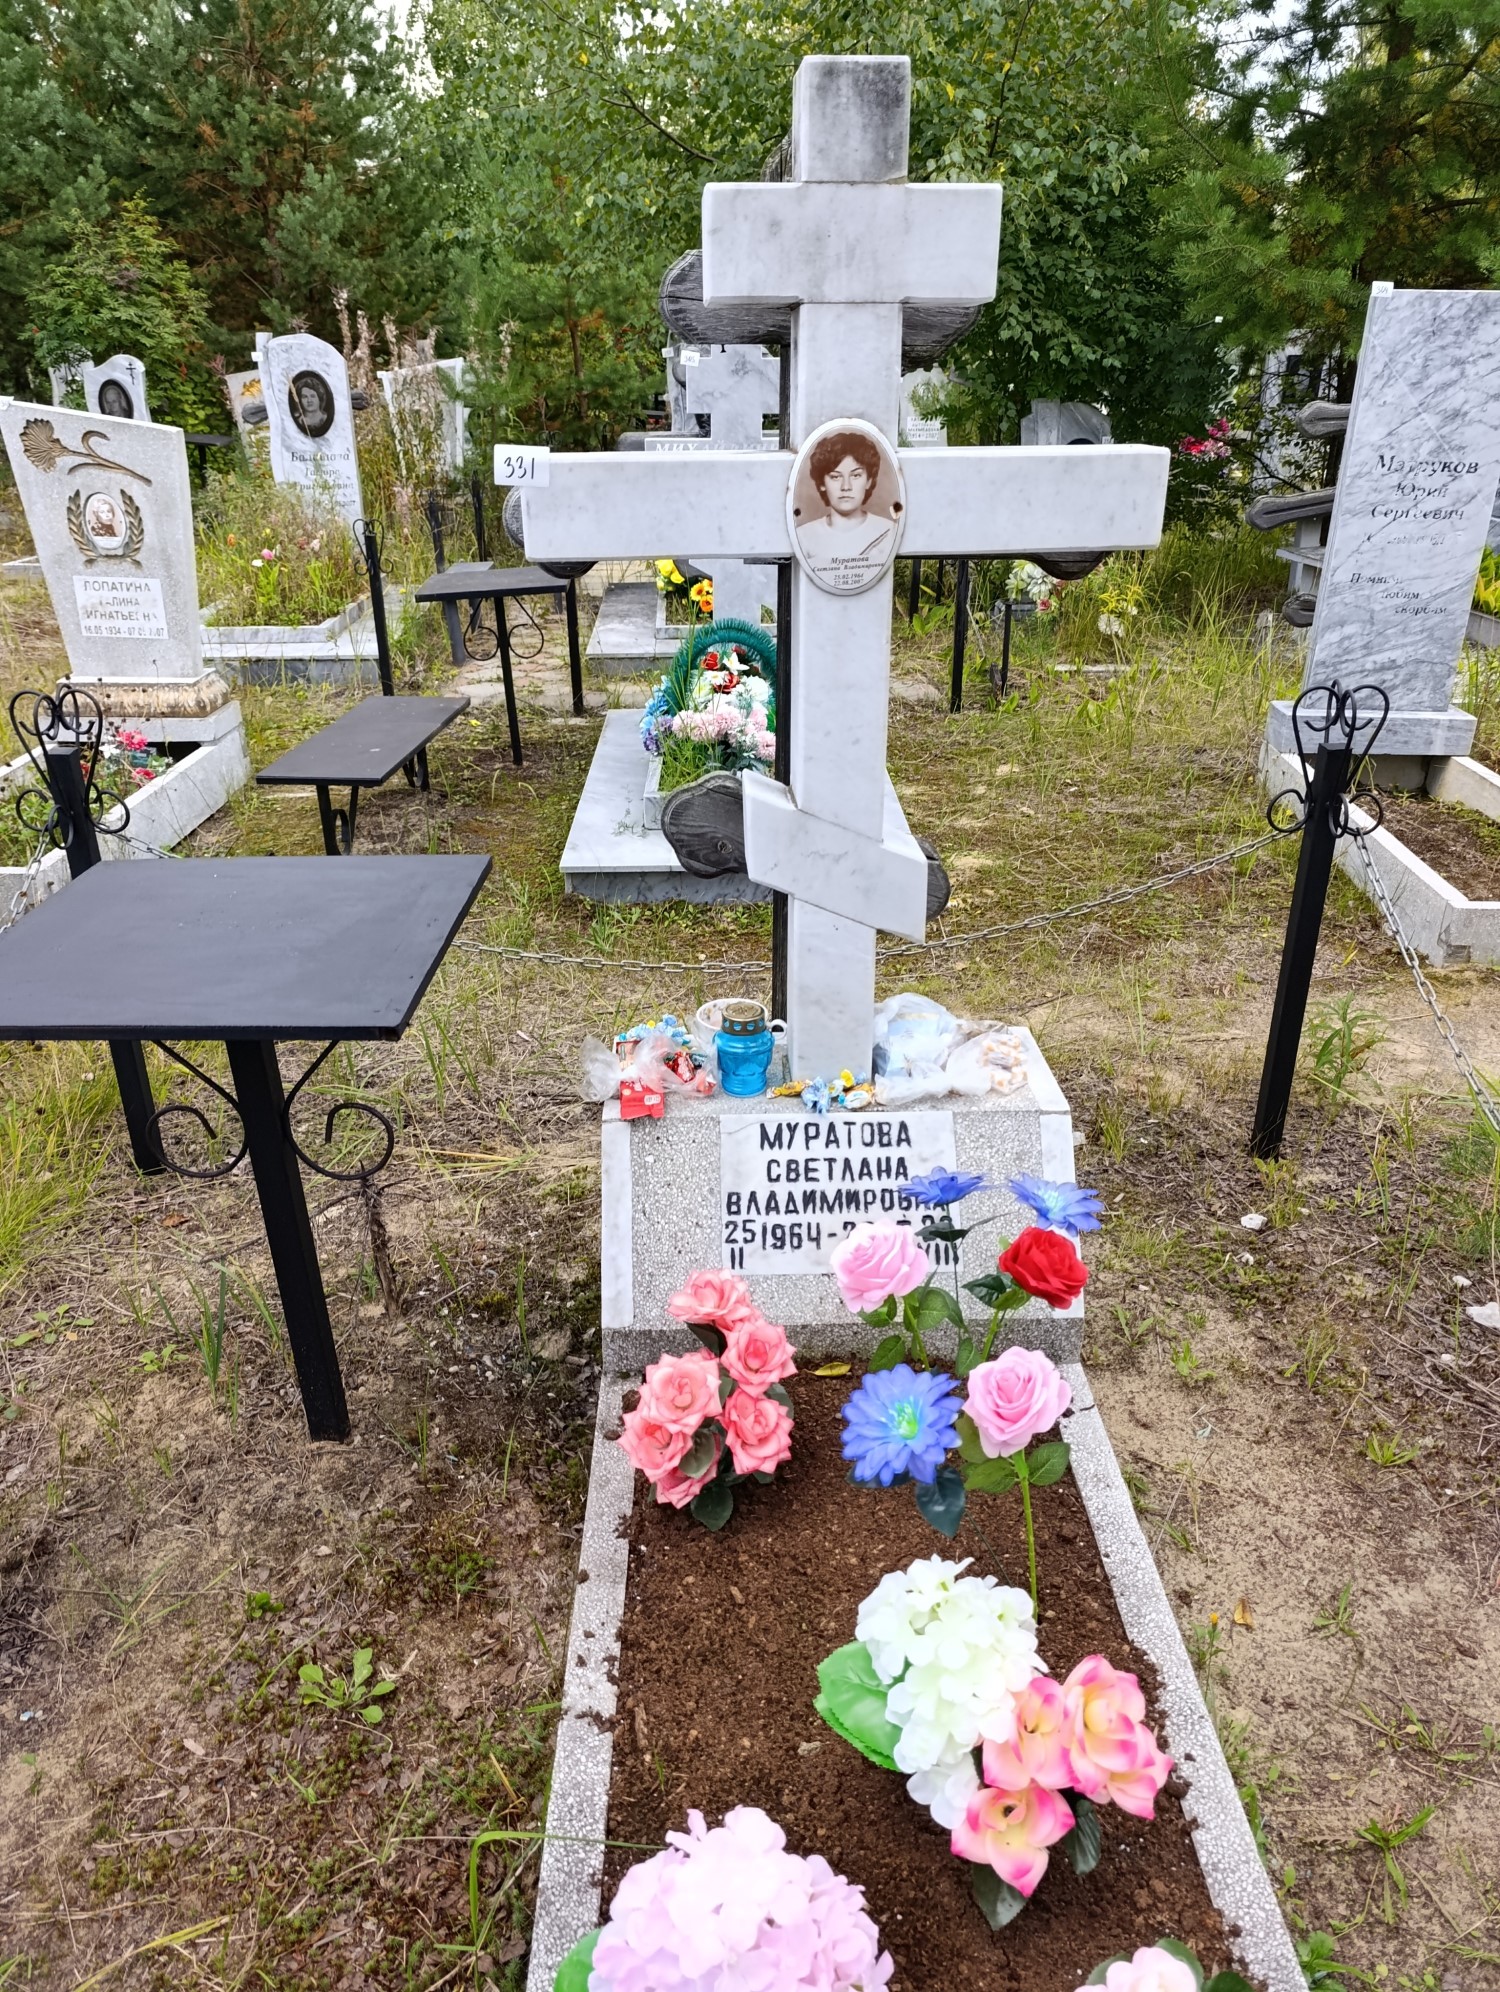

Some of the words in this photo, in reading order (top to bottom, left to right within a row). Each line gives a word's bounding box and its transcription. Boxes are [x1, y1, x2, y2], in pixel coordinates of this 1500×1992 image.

[503, 455, 536, 480] 331
[1371, 503, 1465, 521] Сергеевич
[831, 556, 870, 566] Муратова
[759, 1120, 913, 1151] МУРАТОВА
[766, 1155, 910, 1184] СВЕТЛАНА
[724, 1219, 758, 1245] 25
